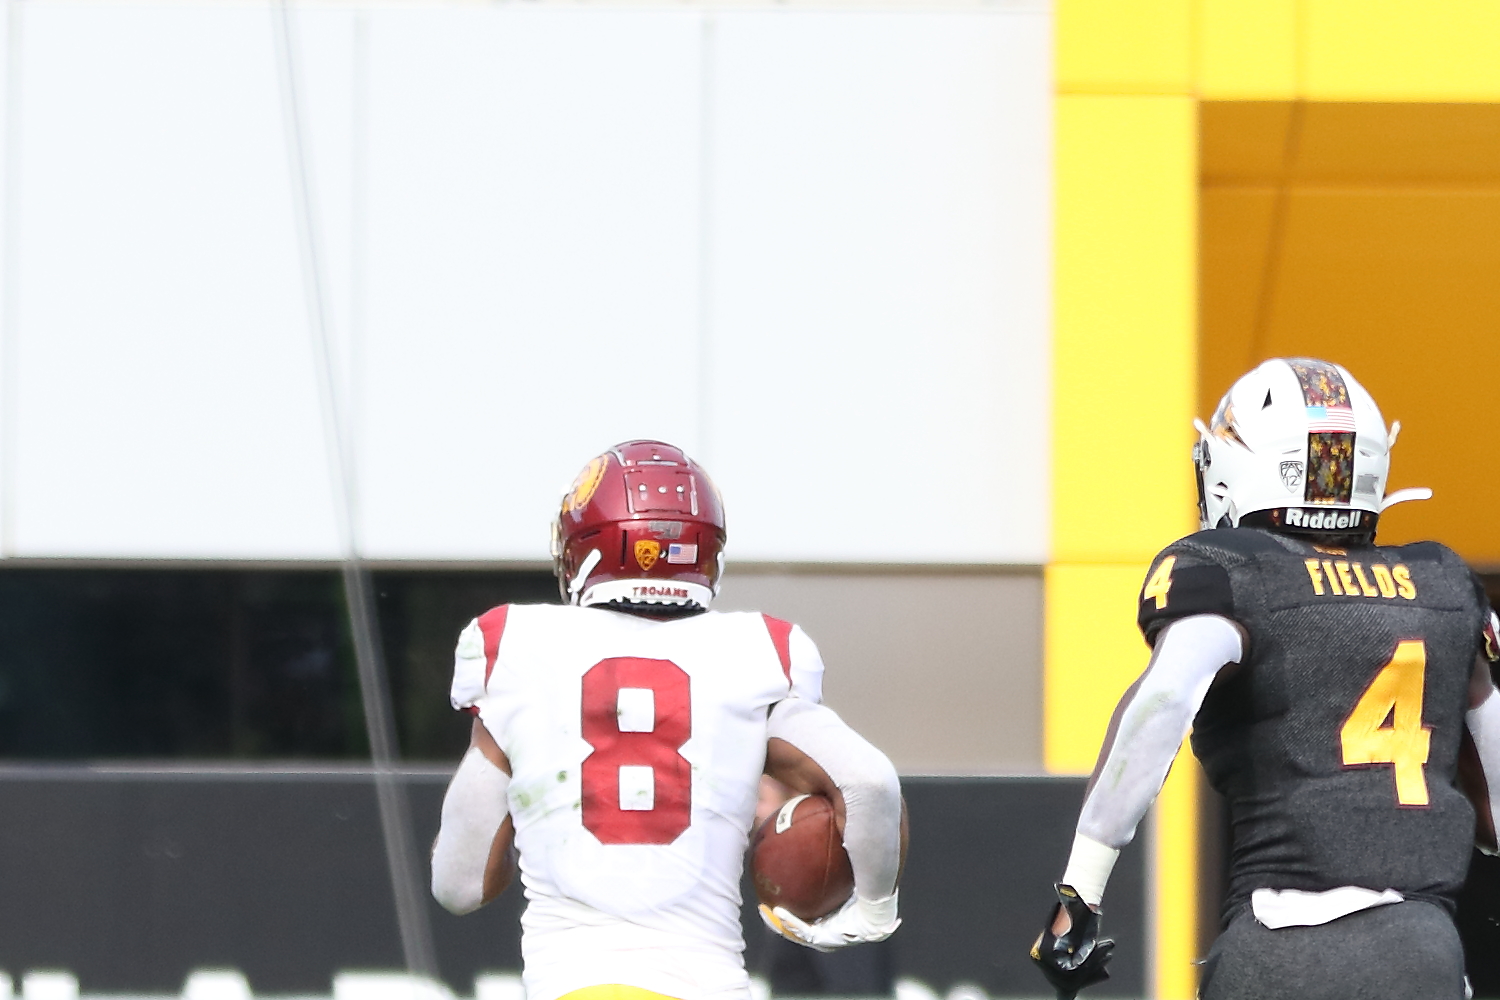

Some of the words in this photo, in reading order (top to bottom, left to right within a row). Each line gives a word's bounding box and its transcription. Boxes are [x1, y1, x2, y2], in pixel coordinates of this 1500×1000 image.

[1285, 507, 1361, 530] Riddell
[632, 586, 689, 598] TROJANS
[1143, 555, 1177, 610] 4
[1304, 557, 1417, 600] FIELDS
[1339, 639, 1433, 807] 4
[581, 656, 691, 845] 8
